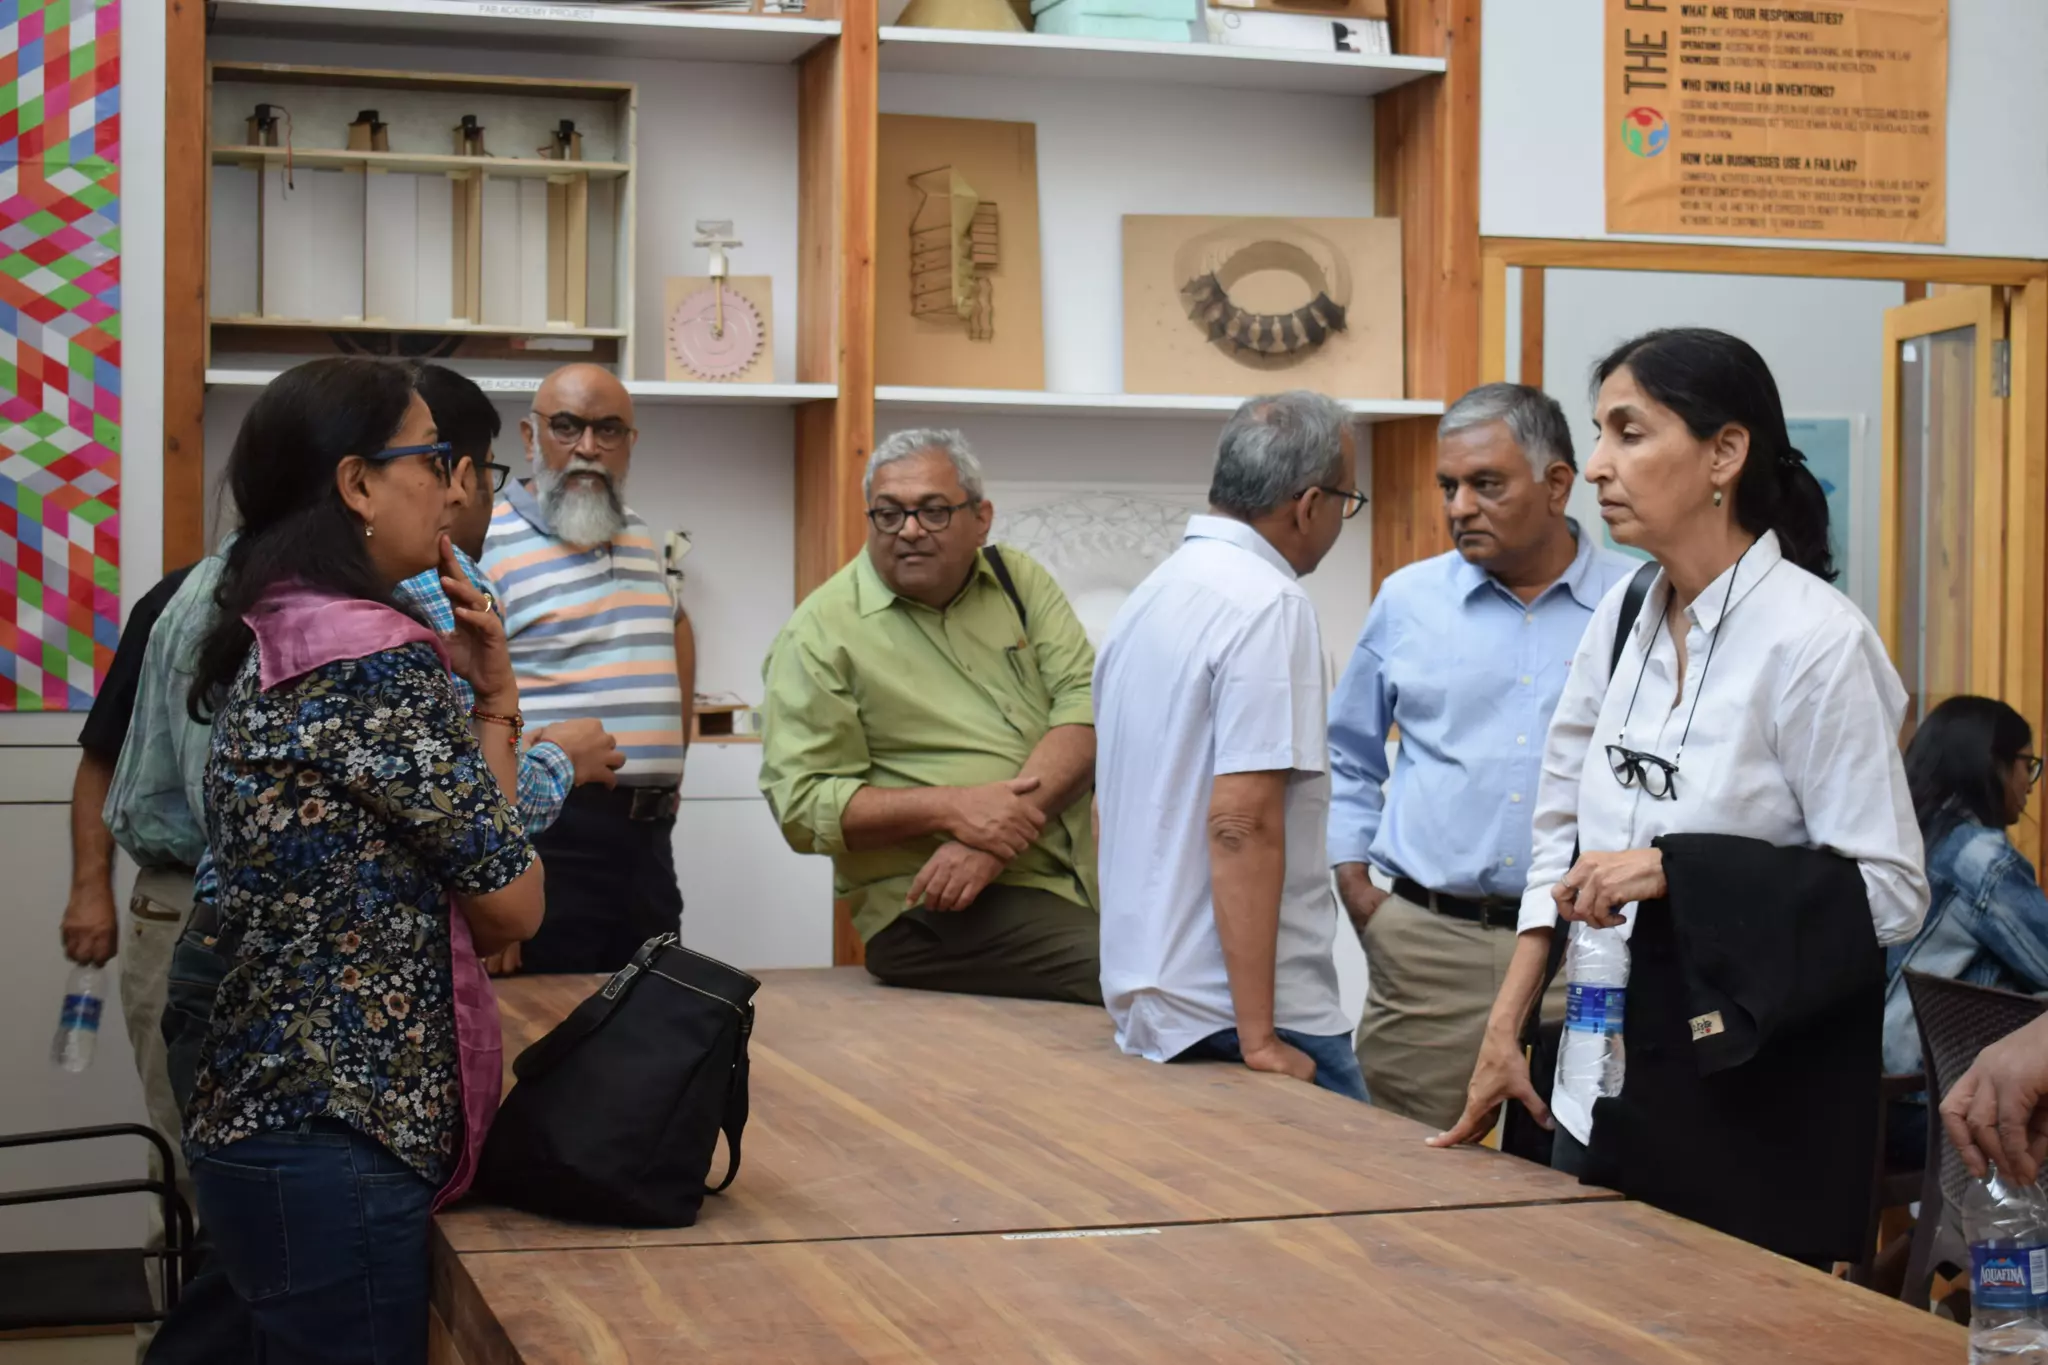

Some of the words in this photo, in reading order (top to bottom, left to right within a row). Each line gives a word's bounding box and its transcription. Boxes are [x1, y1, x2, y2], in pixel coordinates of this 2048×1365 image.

[500, 5, 546, 16] ACADEMY
[1680, 5, 1708, 17] WHAT
[1712, 6, 1729, 19] ARE
[1732, 8, 1756, 19] YOUR
[1759, 8, 1844, 25] RESPONSIBILITIES?
[1624, 28, 1667, 94] THE
[1680, 79, 1701, 91] WHO
[1705, 80, 1730, 93] OWNS
[1734, 81, 1751, 93] FAB
[1755, 82, 1773, 95] LAB
[1775, 83, 1835, 97] INVENTIONS?
[1680, 152, 1701, 165] HOW
[1705, 153, 1723, 166] CAN
[1726, 154, 1780, 169] BUSINESSES
[1783, 156, 1801, 169] USE
[1804, 157, 1811, 169] A
[1814, 158, 1831, 171] FAB
[1833, 158, 1857, 172] LAB?
[1980, 1265, 2025, 1287] AQUAFINA
